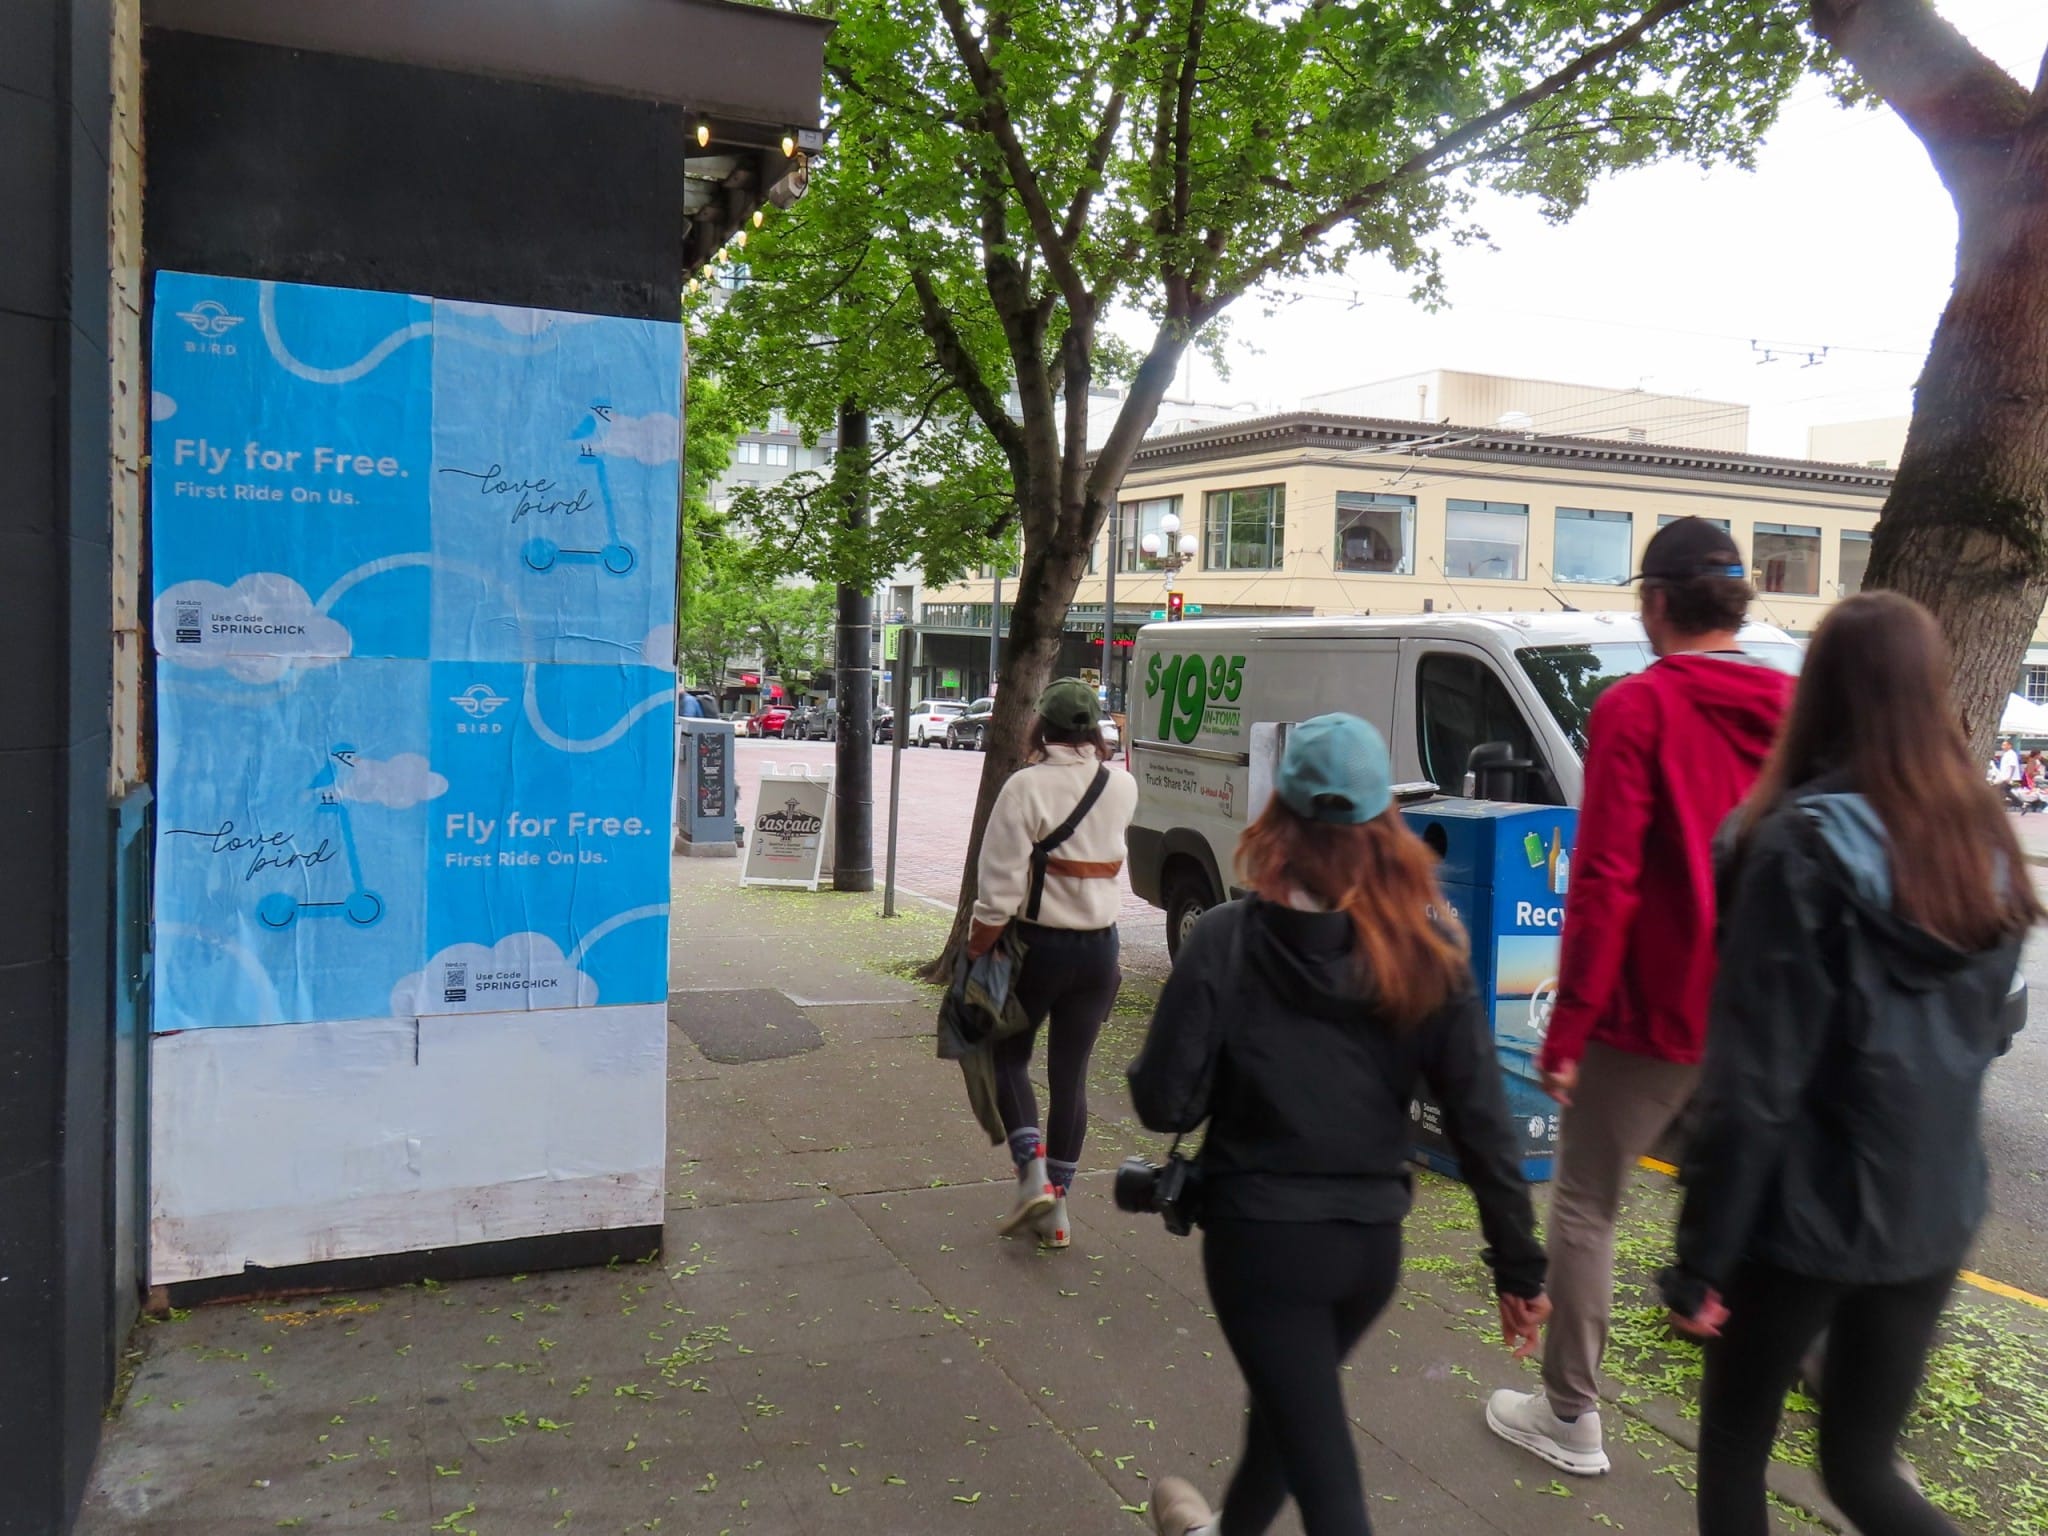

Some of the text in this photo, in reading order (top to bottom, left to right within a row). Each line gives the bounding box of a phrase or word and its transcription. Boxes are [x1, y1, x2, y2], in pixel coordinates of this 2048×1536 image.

[184, 341, 237, 355] BIRD
[174, 438, 409, 478] Fly for Free.
[439, 464, 556, 495] love
[174, 481, 360, 505] First Ride On Us.
[511, 489, 594, 524] bird
[211, 614, 263, 623] Use Code
[211, 624, 306, 635] SPRINGCHICK
[1203, 710, 1240, 726] IN-TOWN
[457, 723, 502, 733] BIRD
[1145, 772, 1198, 794] Truck Share 24/7
[1200, 786, 1218, 798] U-Haul
[446, 812, 651, 845] Fly for Free.
[756, 815, 821, 833] Cascade
[164, 821, 294, 853] love
[246, 839, 337, 881] bird
[445, 850, 608, 868] First Ride On Us.
[475, 971, 522, 981] Use Code
[475, 979, 558, 992] SPRINGCHICK
